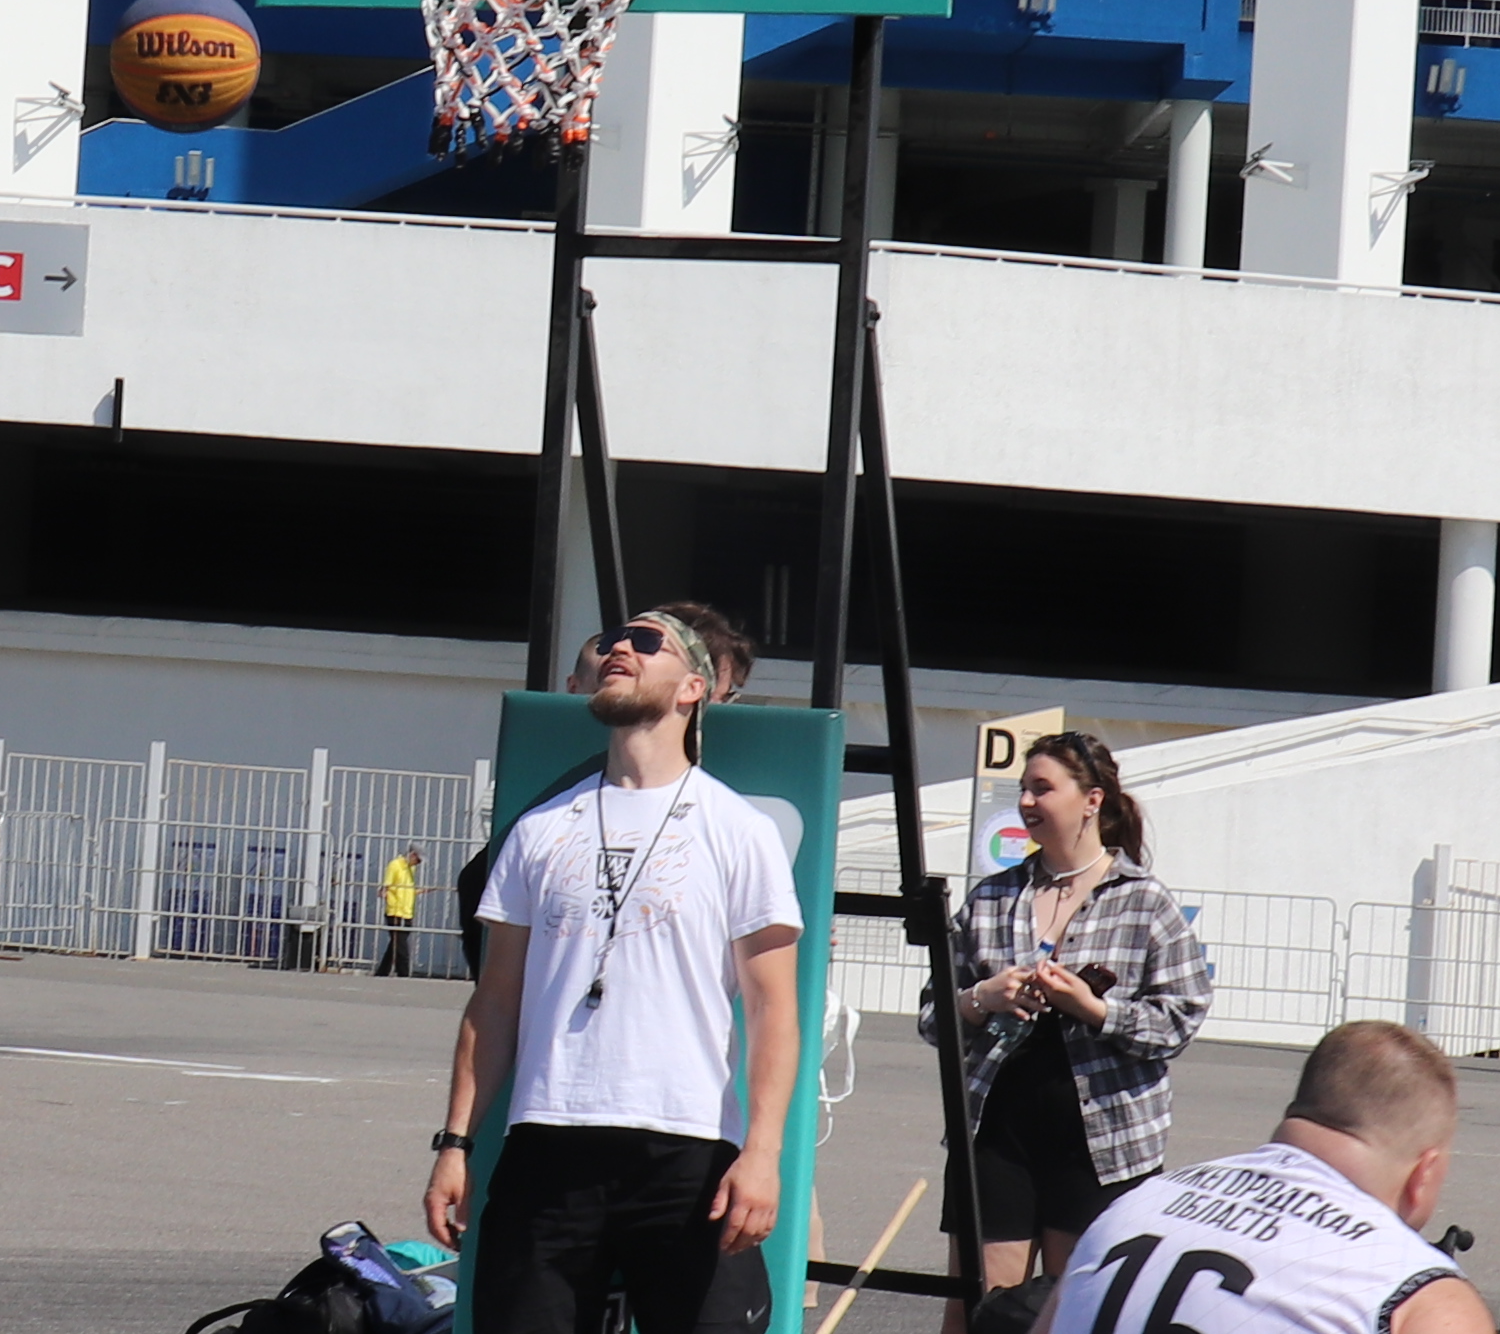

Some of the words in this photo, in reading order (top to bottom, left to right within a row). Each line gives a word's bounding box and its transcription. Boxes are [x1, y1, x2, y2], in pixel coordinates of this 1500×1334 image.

[136, 30, 236, 59] Wilson
[985, 728, 1016, 770] D
[1162, 1190, 1281, 1243] ОБЛАСТЬ
